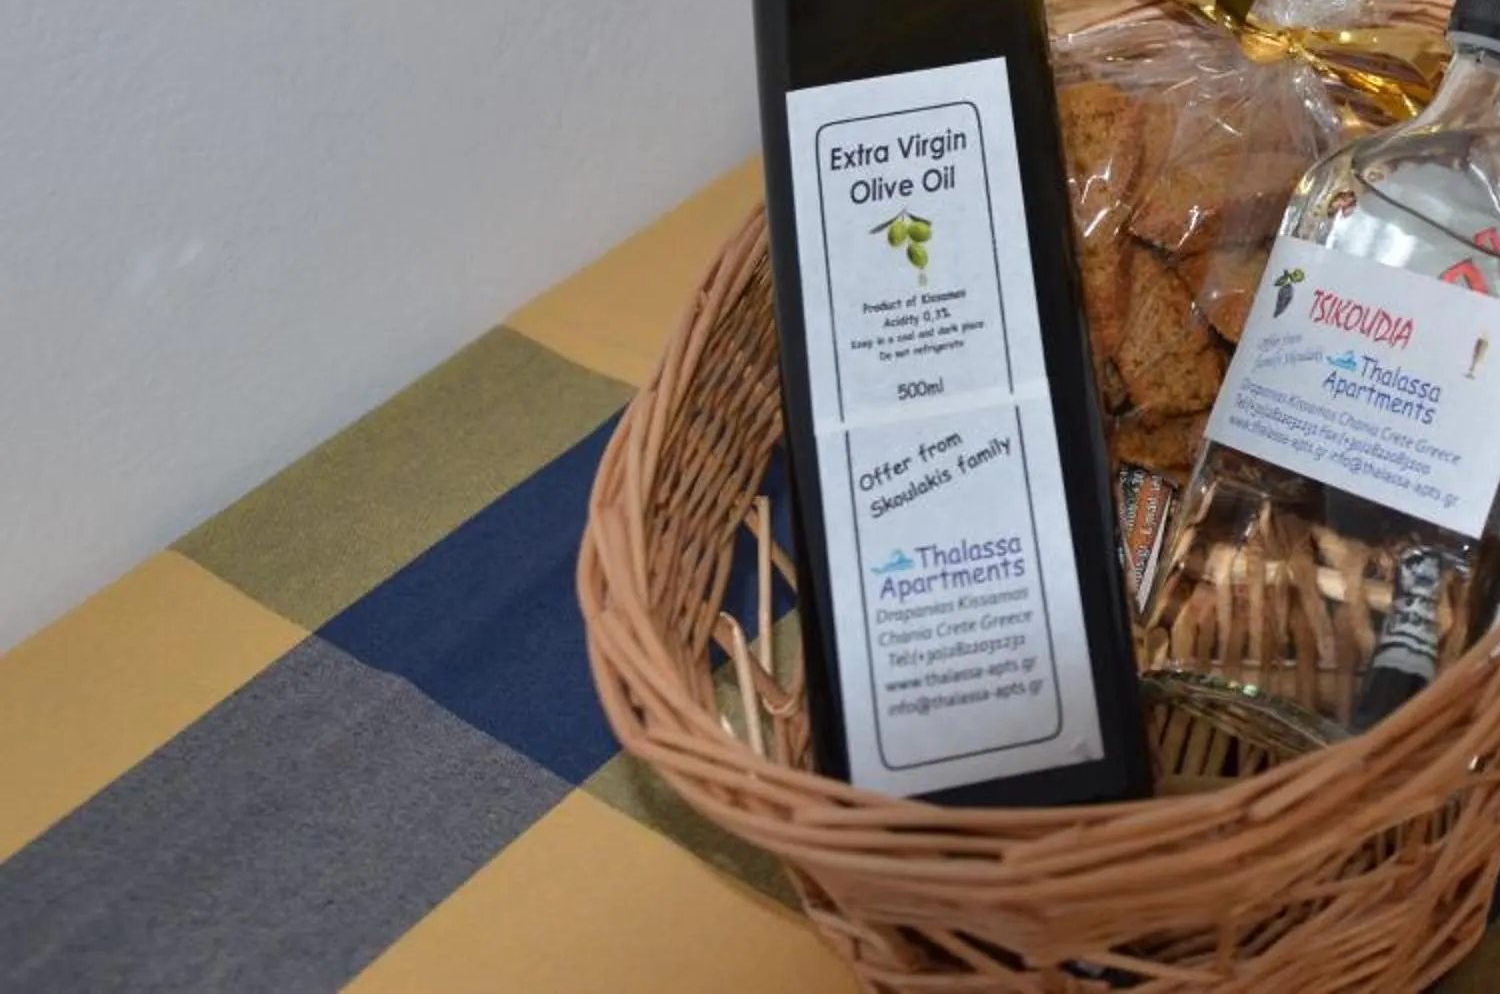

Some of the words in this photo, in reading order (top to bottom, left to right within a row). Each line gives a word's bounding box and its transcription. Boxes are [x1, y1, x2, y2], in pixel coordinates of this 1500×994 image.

[830, 144, 890, 170] Extra
[897, 127, 967, 160] Virgin
[850, 178, 914, 205] Olive
[922, 166, 956, 193] Oil
[863, 298, 902, 314] Product
[906, 294, 917, 307] of
[884, 314, 919, 328] Acidity
[1309, 286, 1414, 349] TSIKOUDIA
[898, 377, 945, 402] 500ml
[1322, 370, 1437, 425] Apartments
[1360, 354, 1442, 404] Thalassa
[858, 457, 912, 492] Offer
[919, 432, 963, 462] from
[1415, 437, 1463, 466] Greece
[870, 468, 953, 519] Skoulakis
[957, 436, 1012, 474] family
[913, 536, 1023, 569] Thalassa
[879, 558, 1026, 602] Apartments
[936, 620, 977, 638] Crete
[979, 609, 1034, 631] Greece
